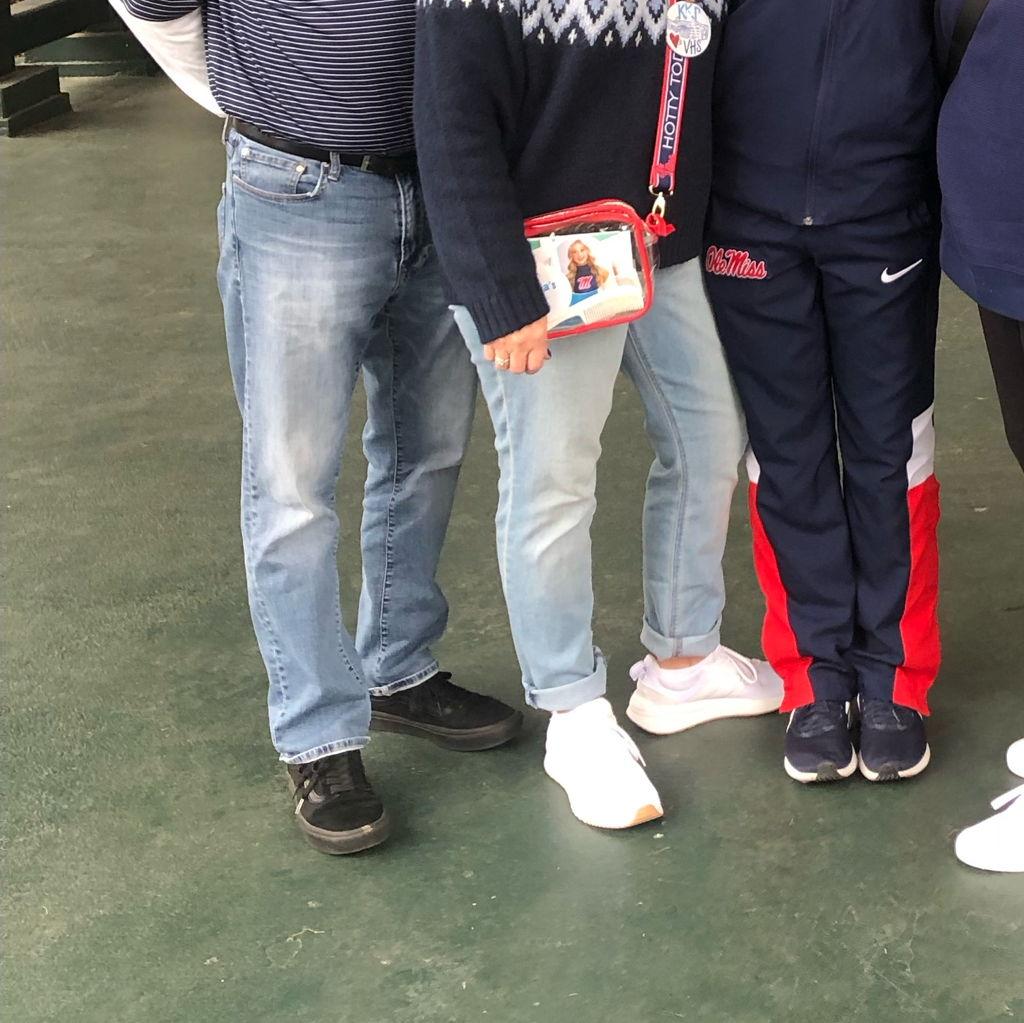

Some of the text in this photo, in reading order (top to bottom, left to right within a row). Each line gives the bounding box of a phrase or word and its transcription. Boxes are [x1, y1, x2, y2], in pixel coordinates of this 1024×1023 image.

[662, 90, 679, 150] HOTTY
[706, 245, 768, 280] Ole Miss
